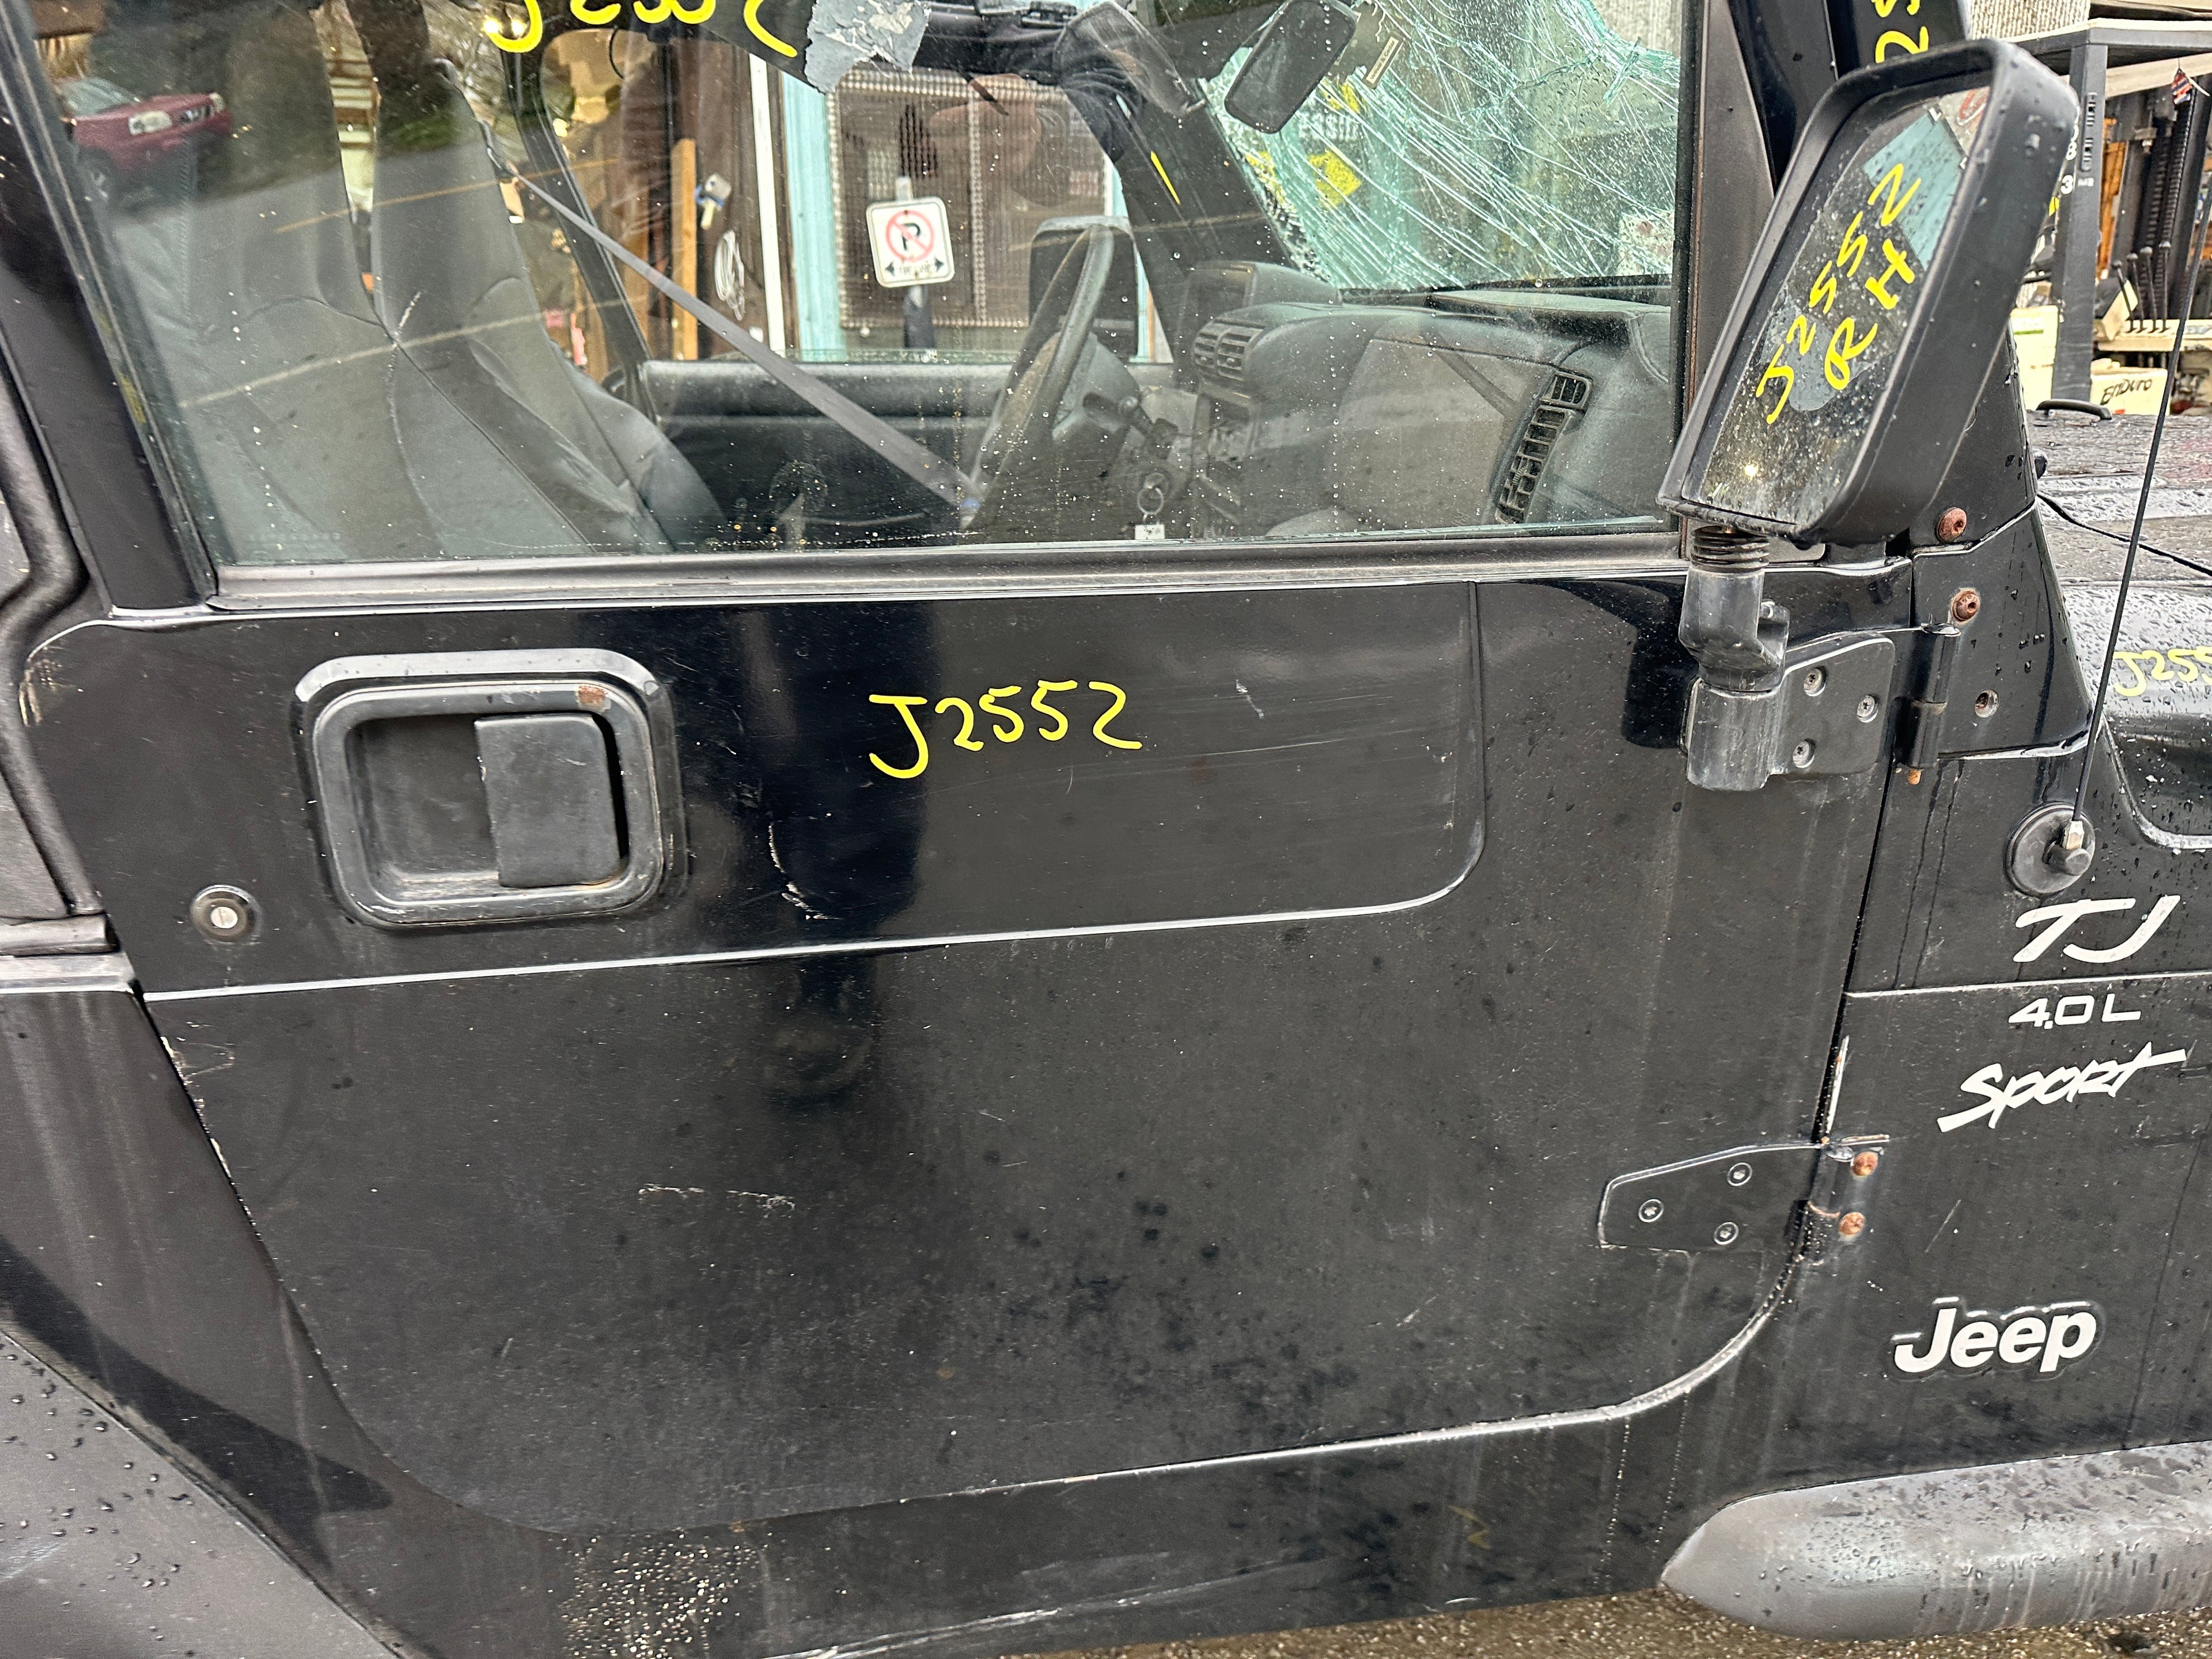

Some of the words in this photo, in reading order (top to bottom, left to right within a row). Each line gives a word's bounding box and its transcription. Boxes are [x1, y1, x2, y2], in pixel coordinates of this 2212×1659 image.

[869, 680, 1142, 779] J2552
[2013, 895, 2181, 963] TJ
[1937, 1041, 2187, 1132] Sport
[1895, 1306, 2097, 1372] Jeep
